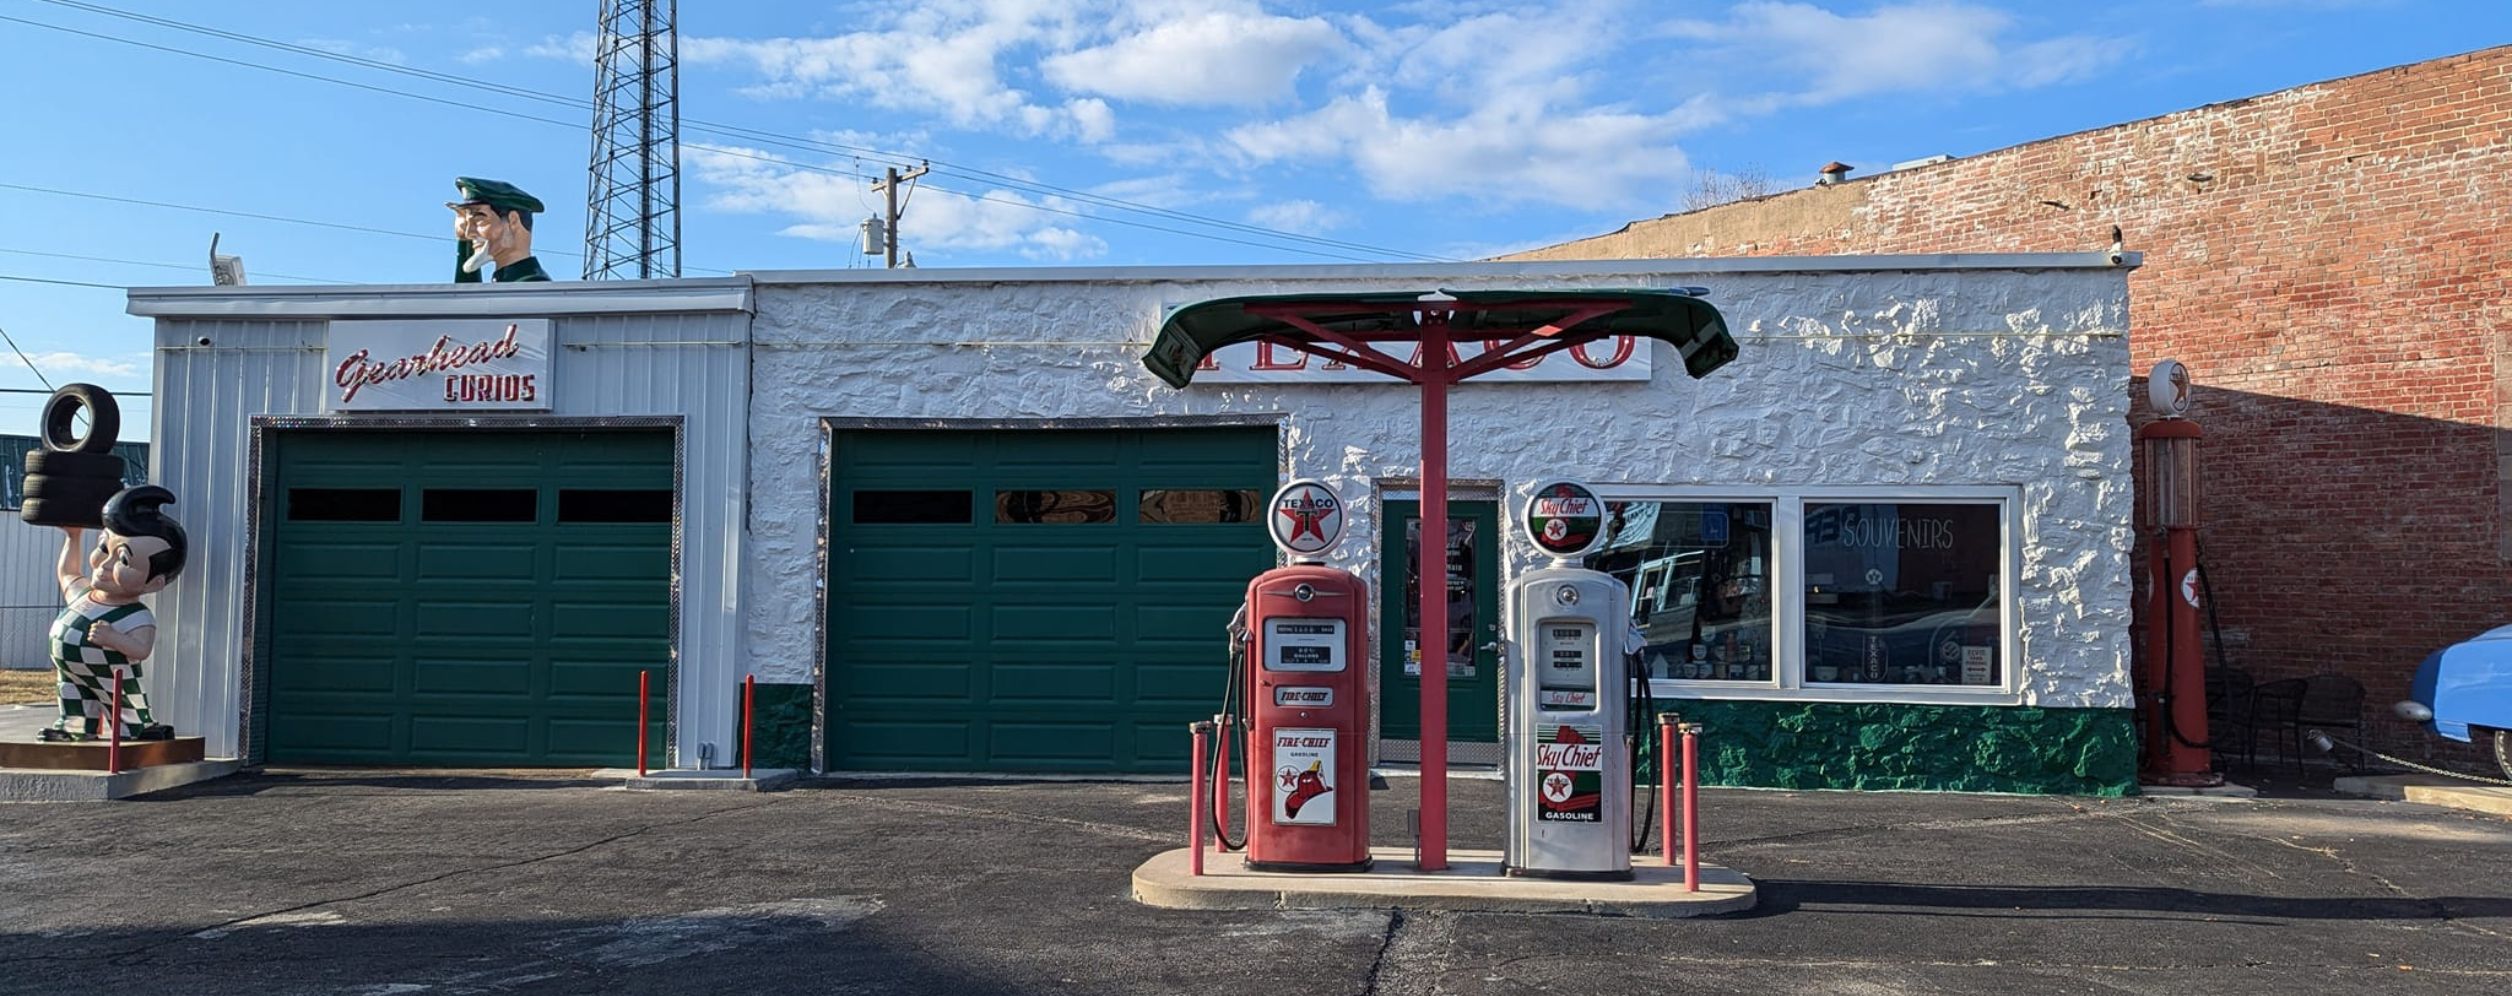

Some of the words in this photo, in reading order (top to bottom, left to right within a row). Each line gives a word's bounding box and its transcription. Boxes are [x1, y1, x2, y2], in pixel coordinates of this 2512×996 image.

[335, 324, 519, 403] Gearhead
[444, 374, 536, 402] CURIOS
[1283, 499, 1334, 508] TEXACO
[1541, 498, 1559, 516] Sky
[1560, 498, 1588, 514] Chief
[1843, 513, 1954, 549] SOUVENIRS
[1280, 692, 1329, 702] FIRE-CHIEF
[1277, 736, 1331, 748] FIRE-CHIEF
[1537, 744, 1561, 770] Sky
[1562, 744, 1602, 767] Chief
[1545, 812, 1594, 820] GASOLINE
